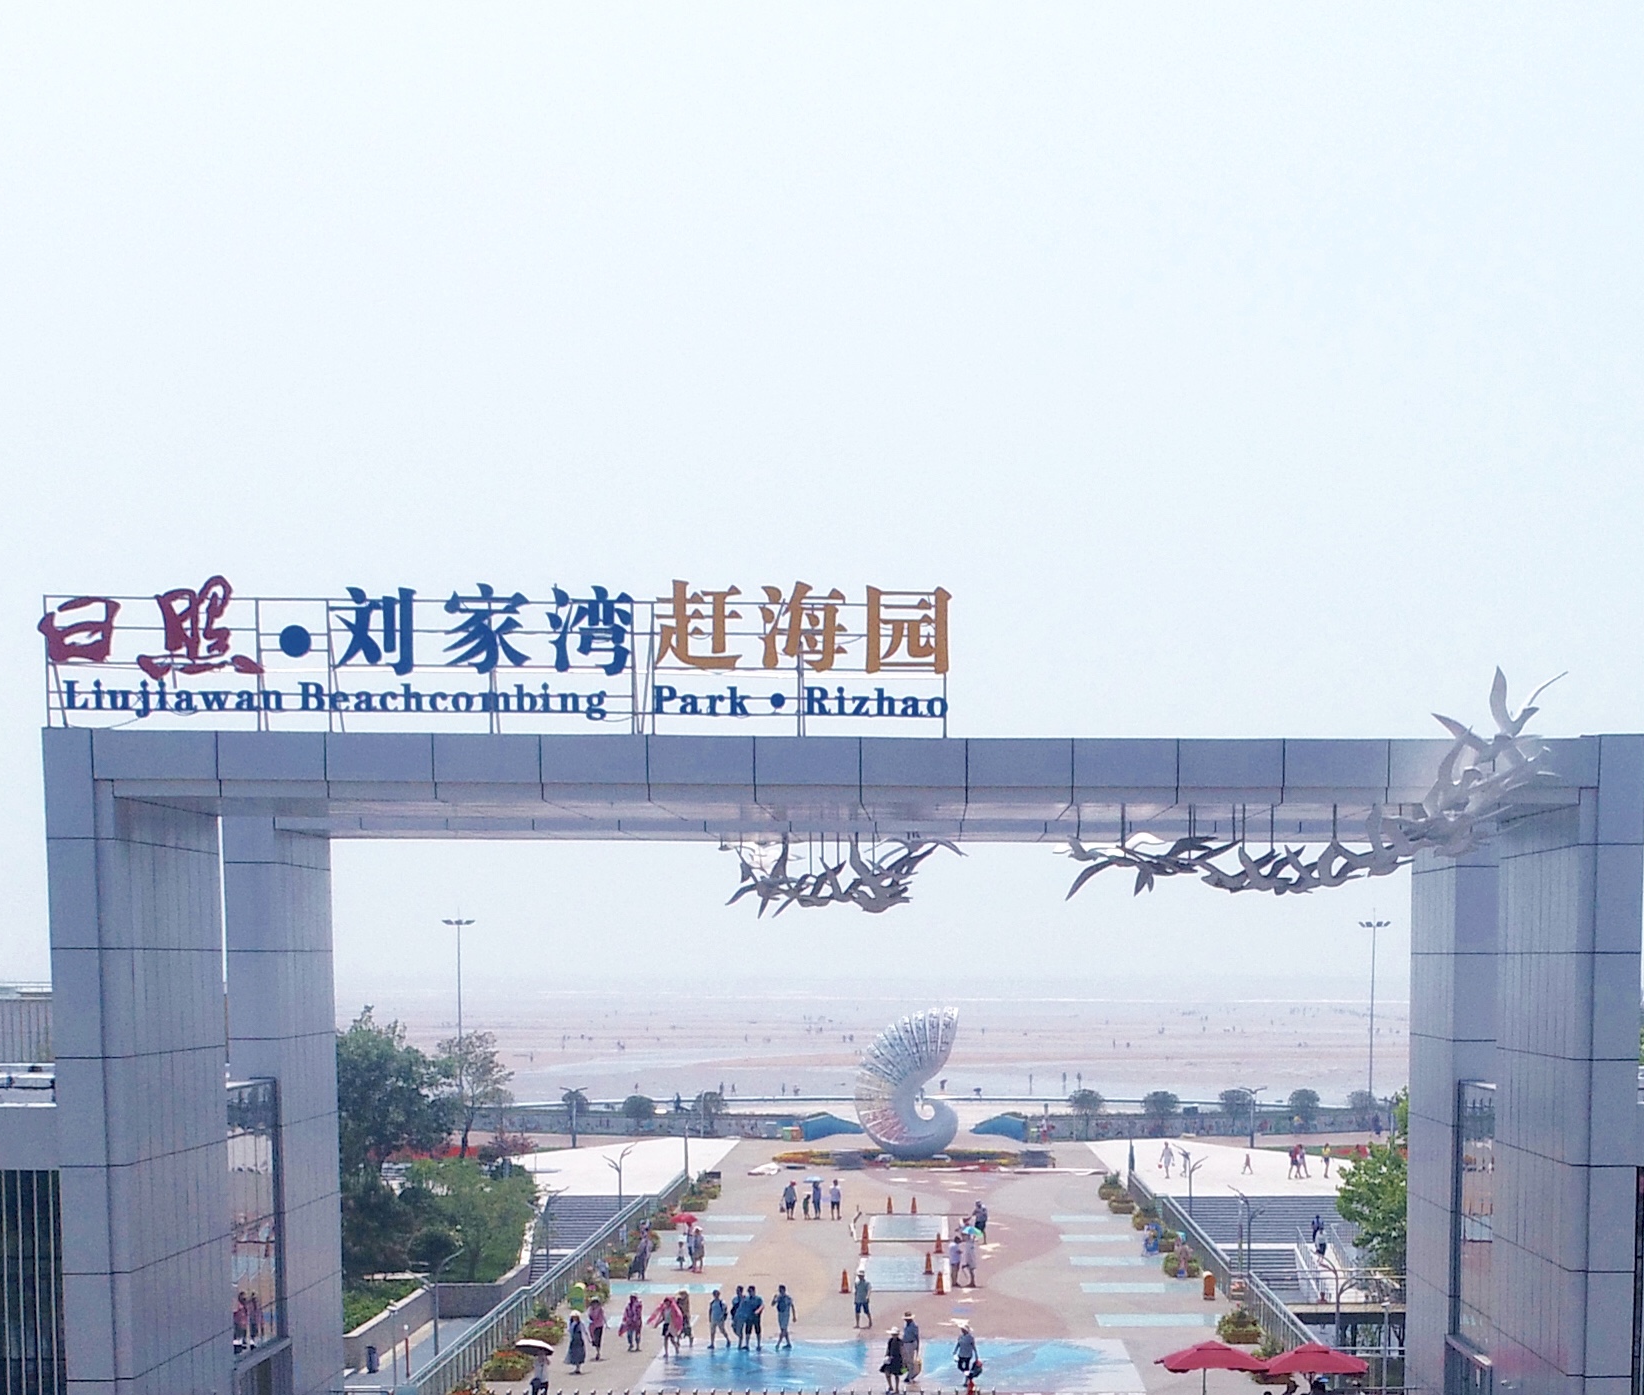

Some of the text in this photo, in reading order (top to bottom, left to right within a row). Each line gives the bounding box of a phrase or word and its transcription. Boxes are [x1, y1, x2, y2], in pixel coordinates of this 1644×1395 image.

[62, 679, 283, 718] Liujiawan
[297, 681, 608, 721] Beachcombing
[653, 684, 752, 716] Park
[805, 685, 949, 718] Rizhao
